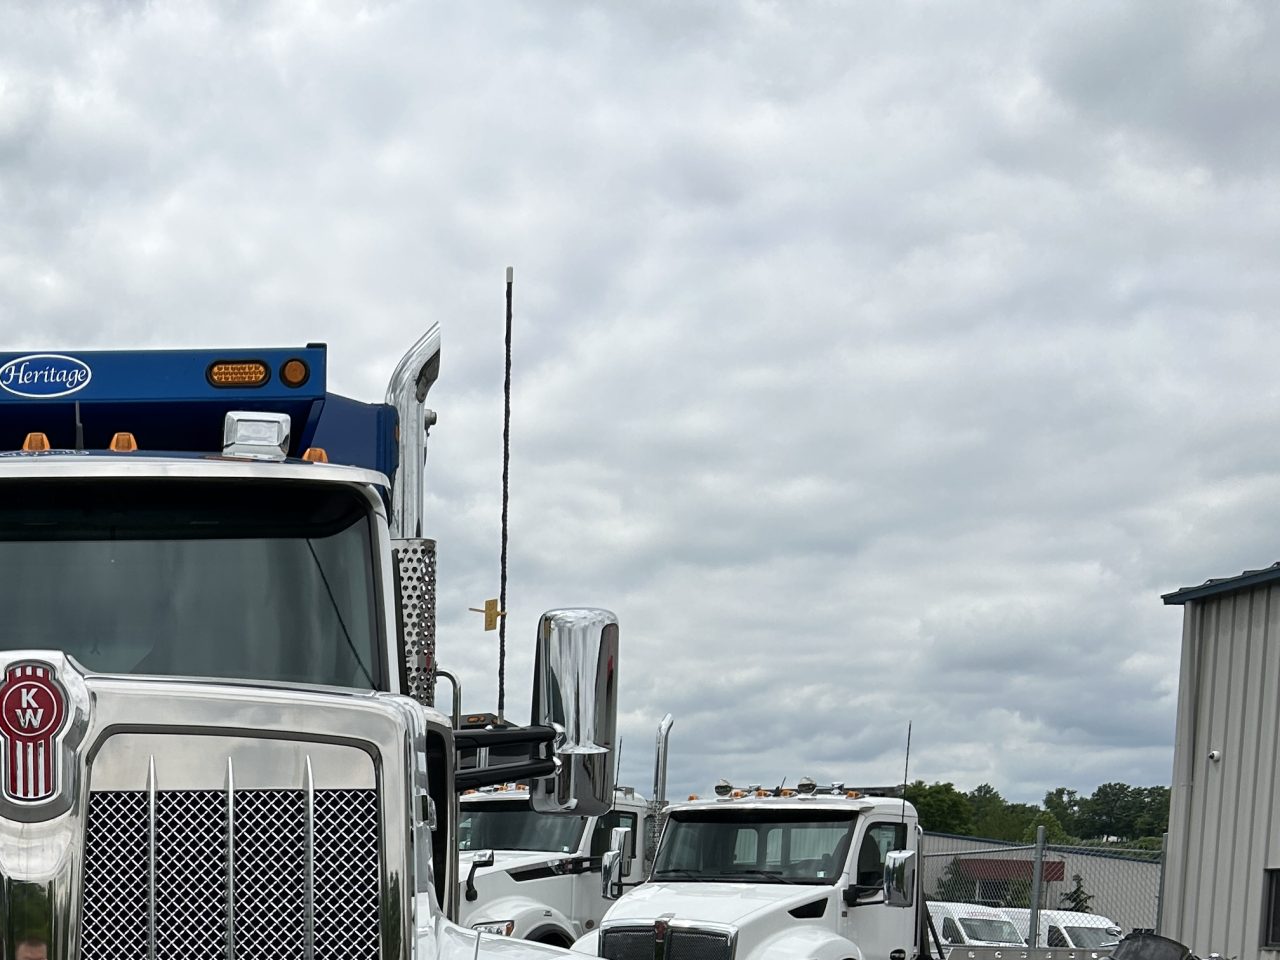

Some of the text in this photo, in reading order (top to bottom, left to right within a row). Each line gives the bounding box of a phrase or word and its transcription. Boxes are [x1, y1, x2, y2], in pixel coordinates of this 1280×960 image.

[2, 361, 87, 388] Heritage
[21, 688, 39, 708] K
[15, 709, 44, 729] W
